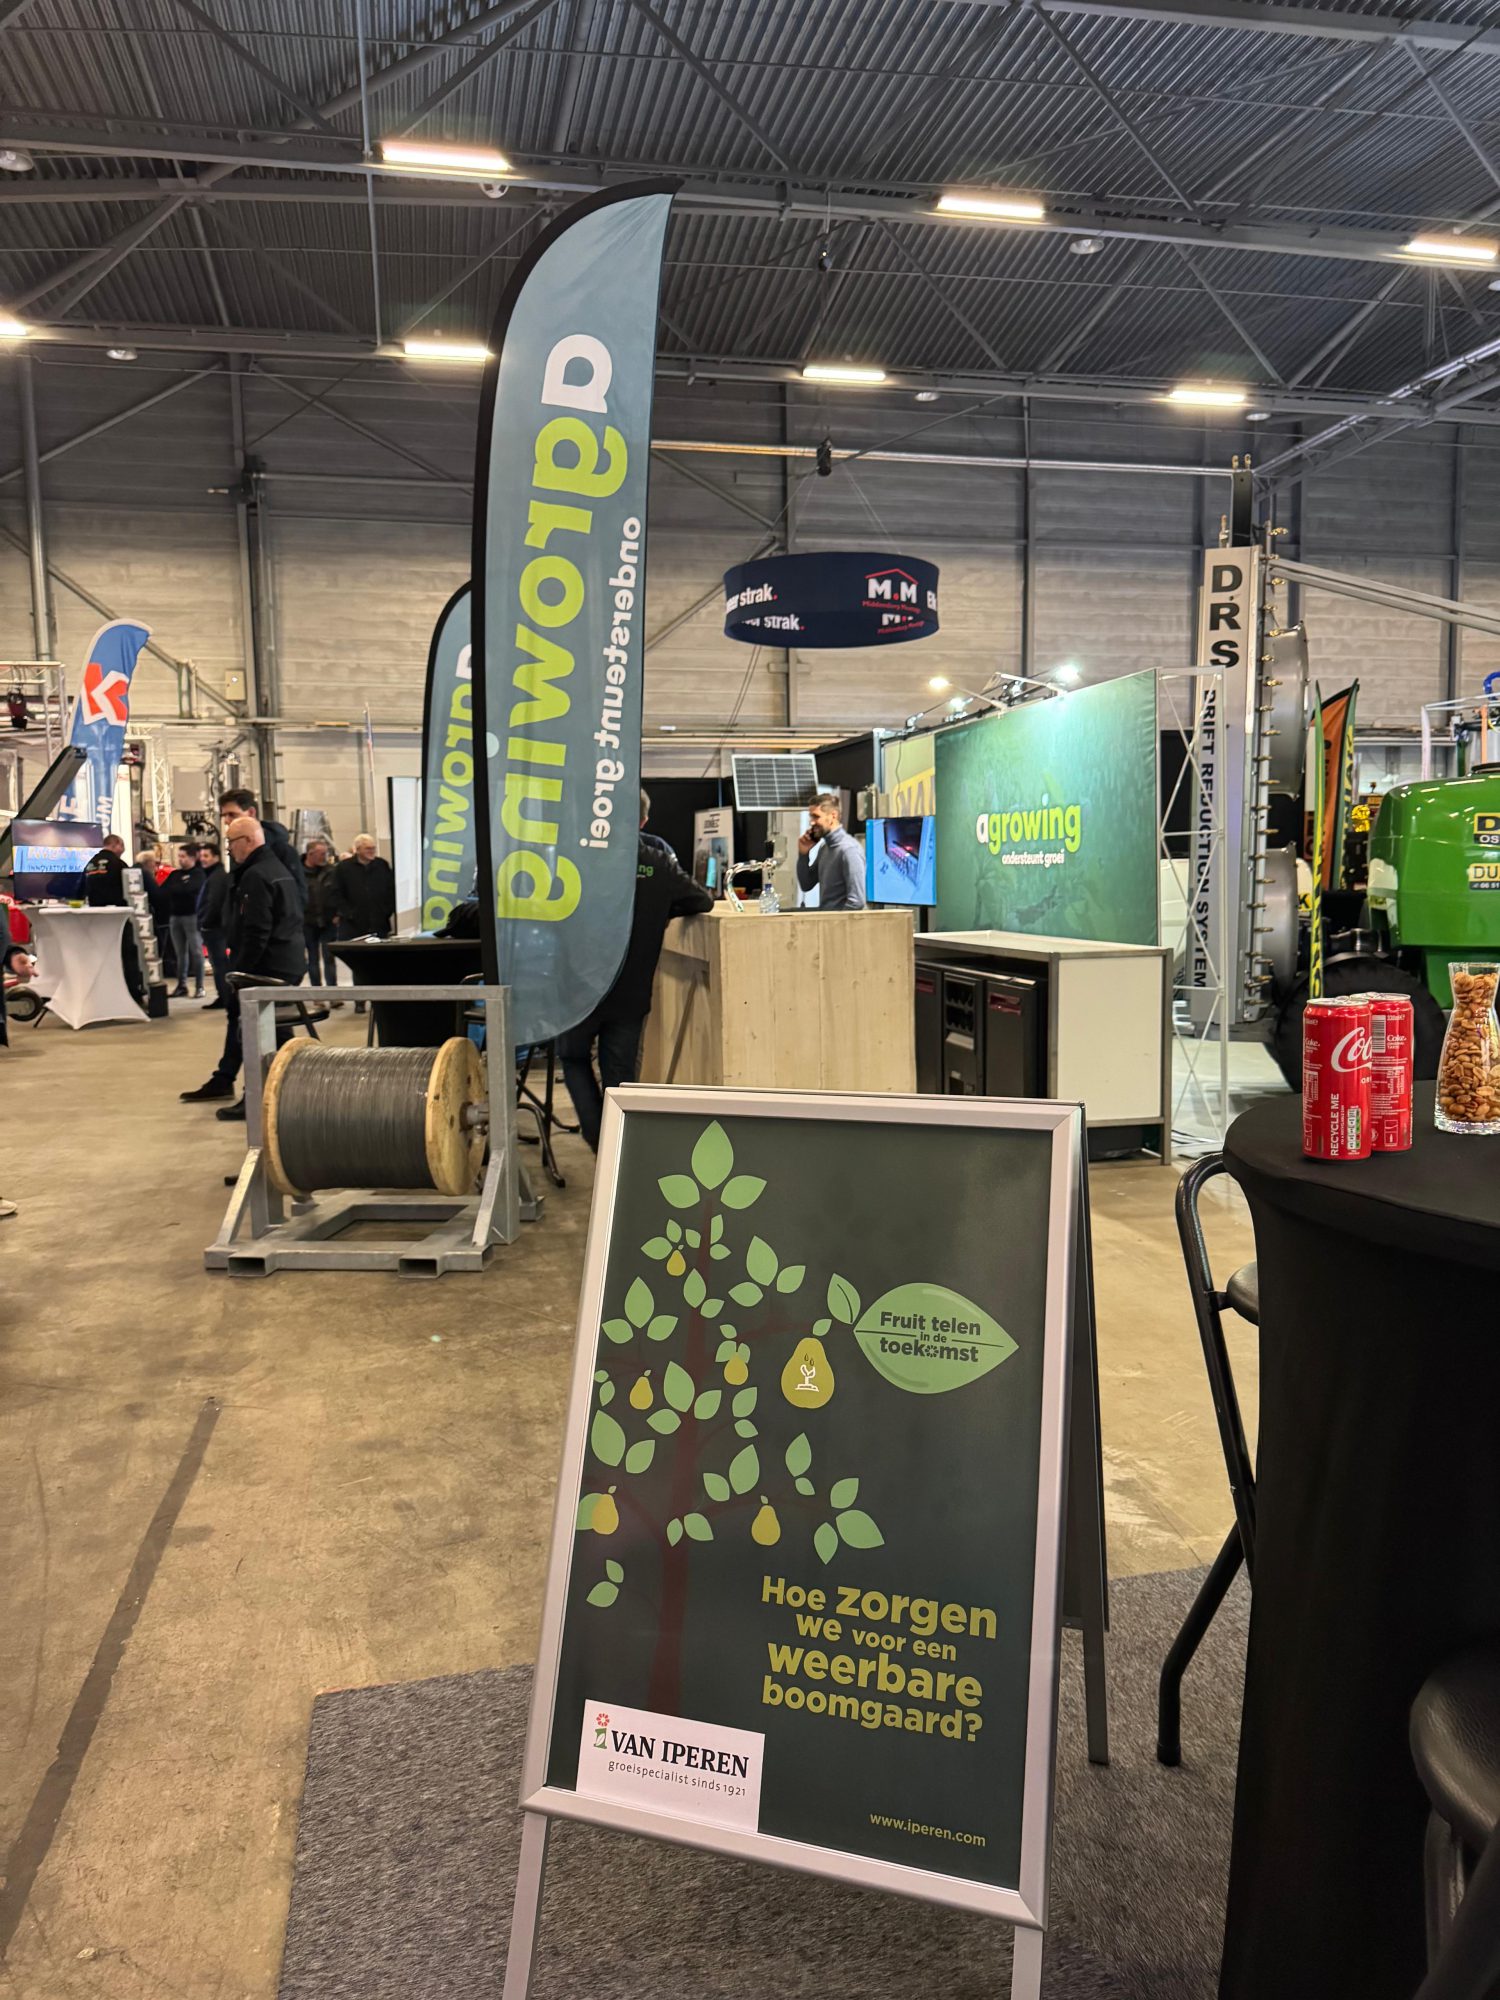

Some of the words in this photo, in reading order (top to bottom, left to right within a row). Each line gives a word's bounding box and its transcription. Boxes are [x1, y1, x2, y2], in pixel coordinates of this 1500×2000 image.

[1201, 689, 1217, 755] DRIFT
[975, 792, 1081, 856] agrowing
[1330, 1093, 1340, 1110] ME
[1330, 1111, 1340, 1156] RECYCLE
[880, 1311, 926, 1331] Fruit
[931, 1315, 981, 1336] telen
[919, 1331, 930, 1342] in
[932, 1332, 947, 1343] de
[880, 1336, 979, 1363] toekomst
[761, 1575, 826, 1611] Hoe
[836, 1586, 997, 1640] zorgen
[796, 1613, 842, 1642] we
[852, 1629, 906, 1652] voor
[912, 1639, 957, 1662] een
[767, 1642, 983, 1708] weerbare
[761, 1675, 983, 1742] boomgaard?
[611, 1730, 656, 1759] VAN
[661, 1740, 750, 1778] IPEREN
[608, 1760, 689, 1785] groeispecialist
[691, 1777, 721, 1792] sinds
[723, 1784, 746, 1797] 1921
[869, 1813, 986, 1847] www.iperen.com
